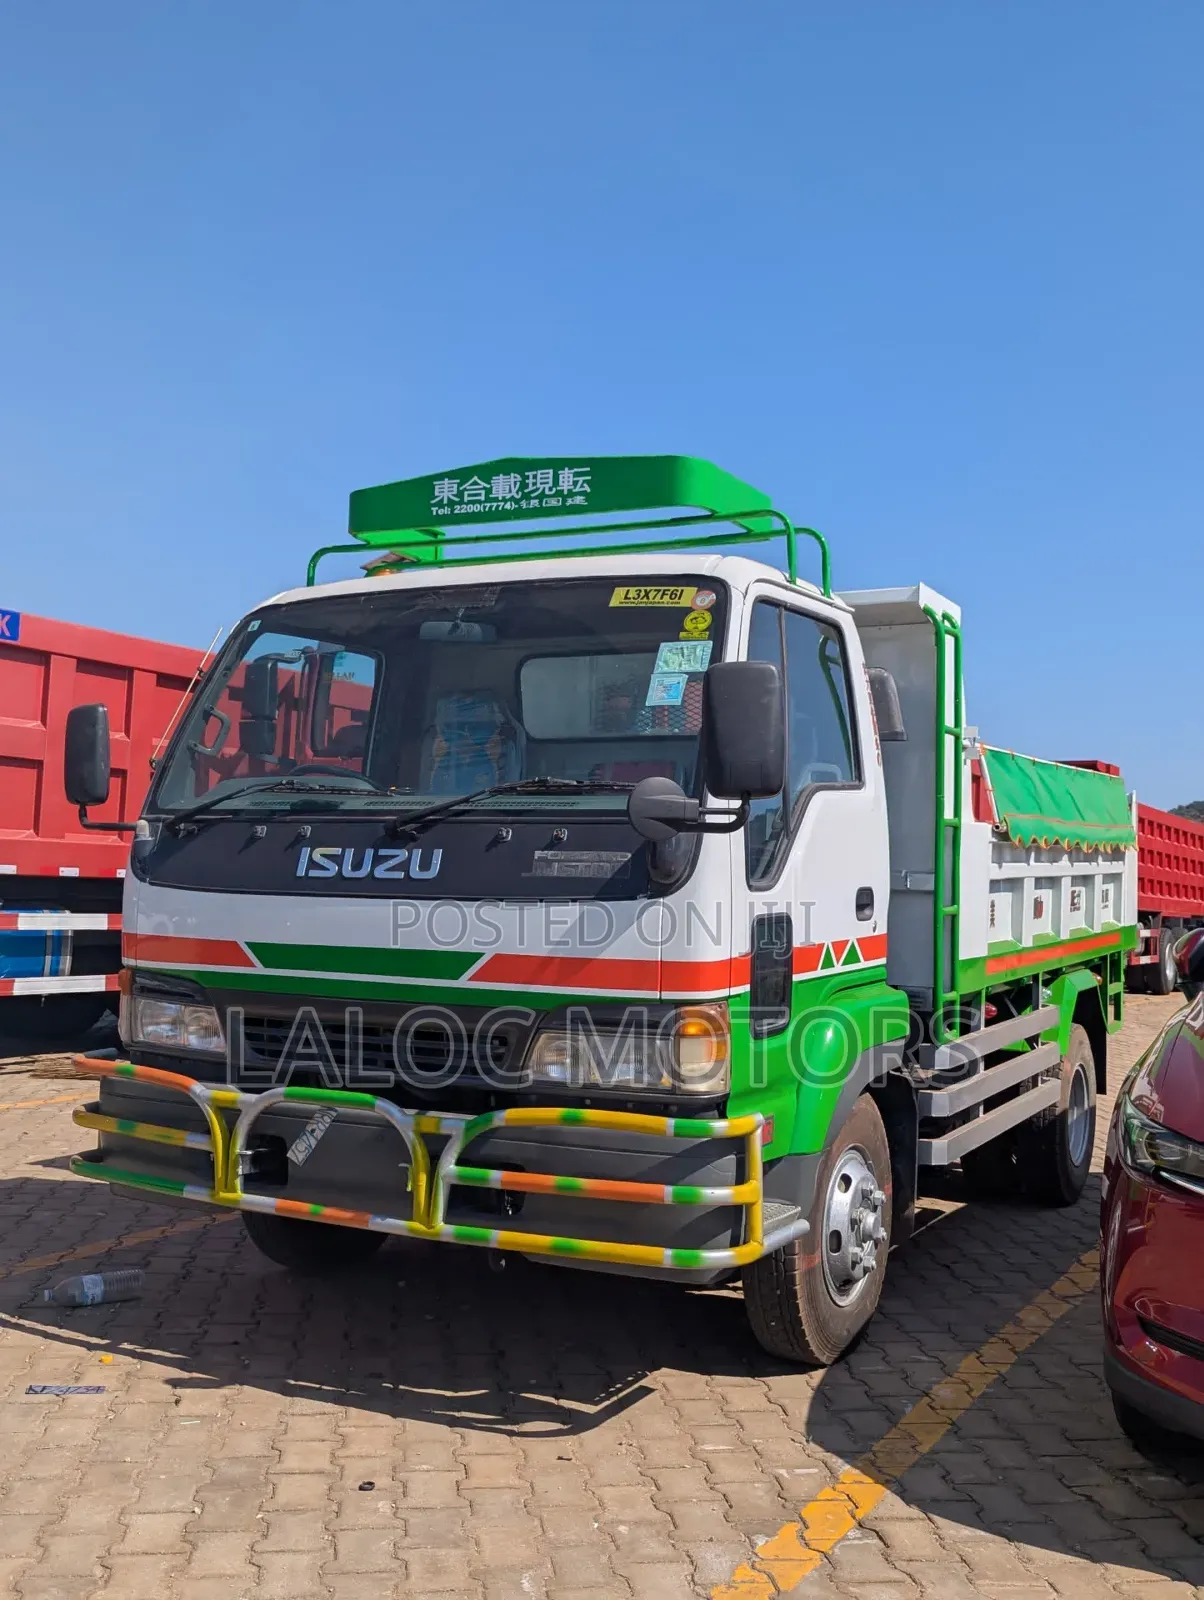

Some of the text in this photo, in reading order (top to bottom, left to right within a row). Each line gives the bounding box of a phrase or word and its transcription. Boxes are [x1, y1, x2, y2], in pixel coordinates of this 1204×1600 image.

[430, 467, 592, 505] 東合載現転
[431, 506, 451, 516] Tel:
[296, 847, 443, 879] ISUZU
